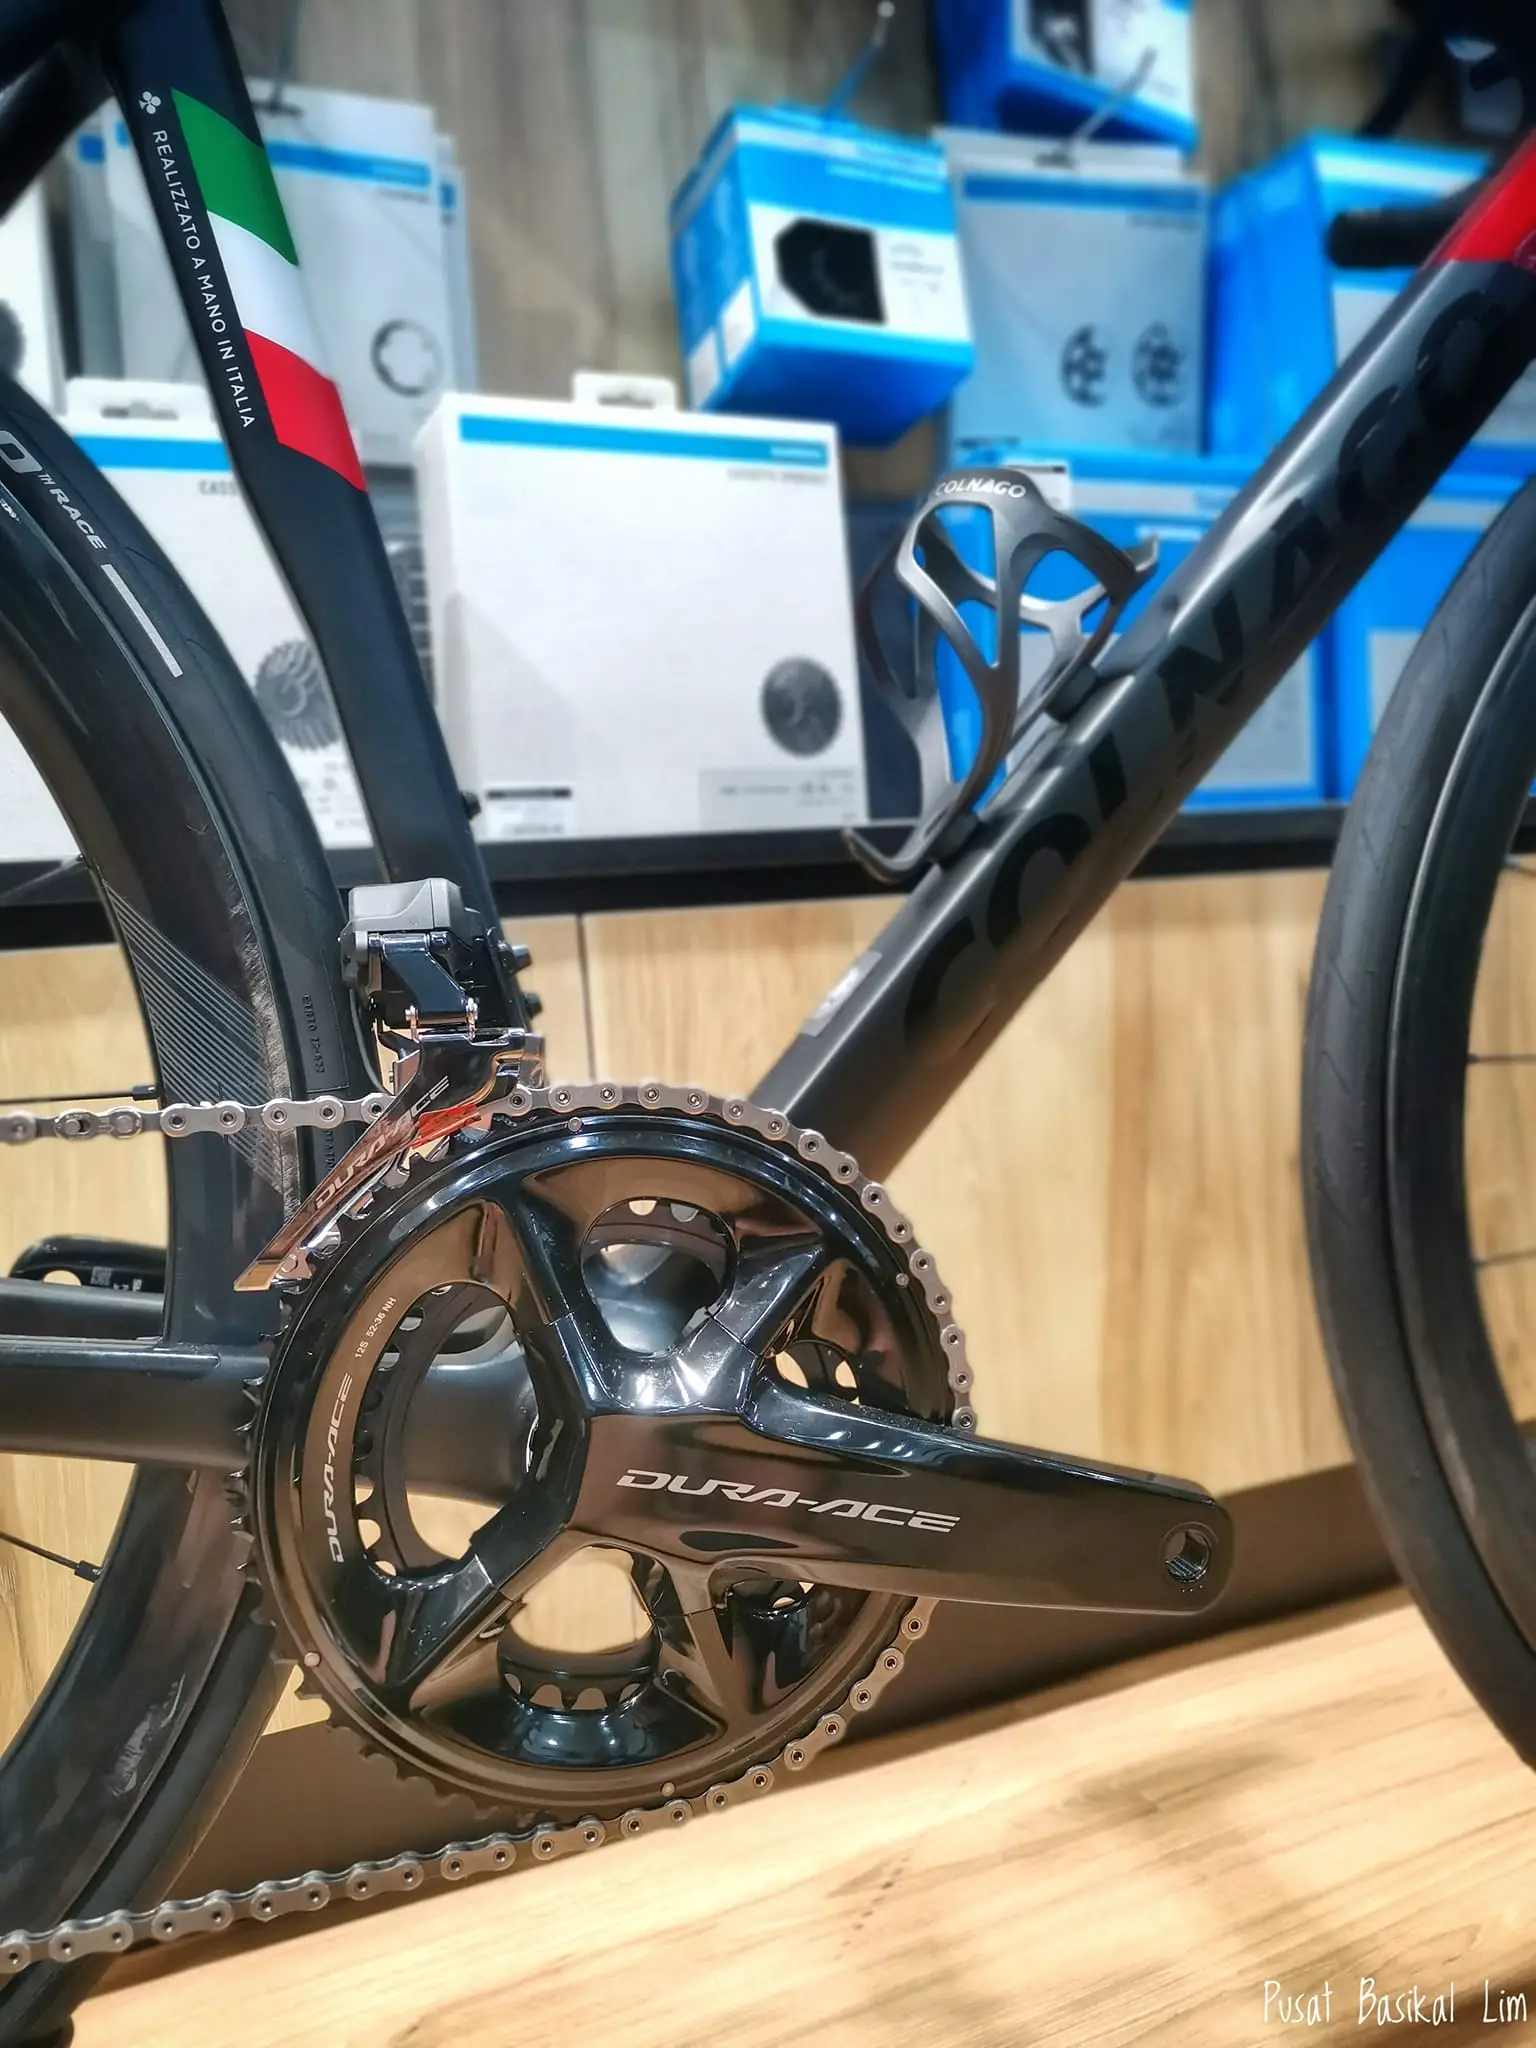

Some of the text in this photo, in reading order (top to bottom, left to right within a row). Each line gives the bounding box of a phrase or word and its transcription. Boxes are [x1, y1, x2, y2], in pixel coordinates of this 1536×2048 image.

[152, 129, 256, 428] REALIZZATO A MANO IN ITALIA
[49, 488, 108, 549] RACE
[935, 477, 1026, 499] COLNAGO
[354, 1296, 397, 1359] 12S 52-36 NH
[323, 1372, 353, 1563] DURA-ACE
[616, 1469, 961, 1533] DURA-ACE
